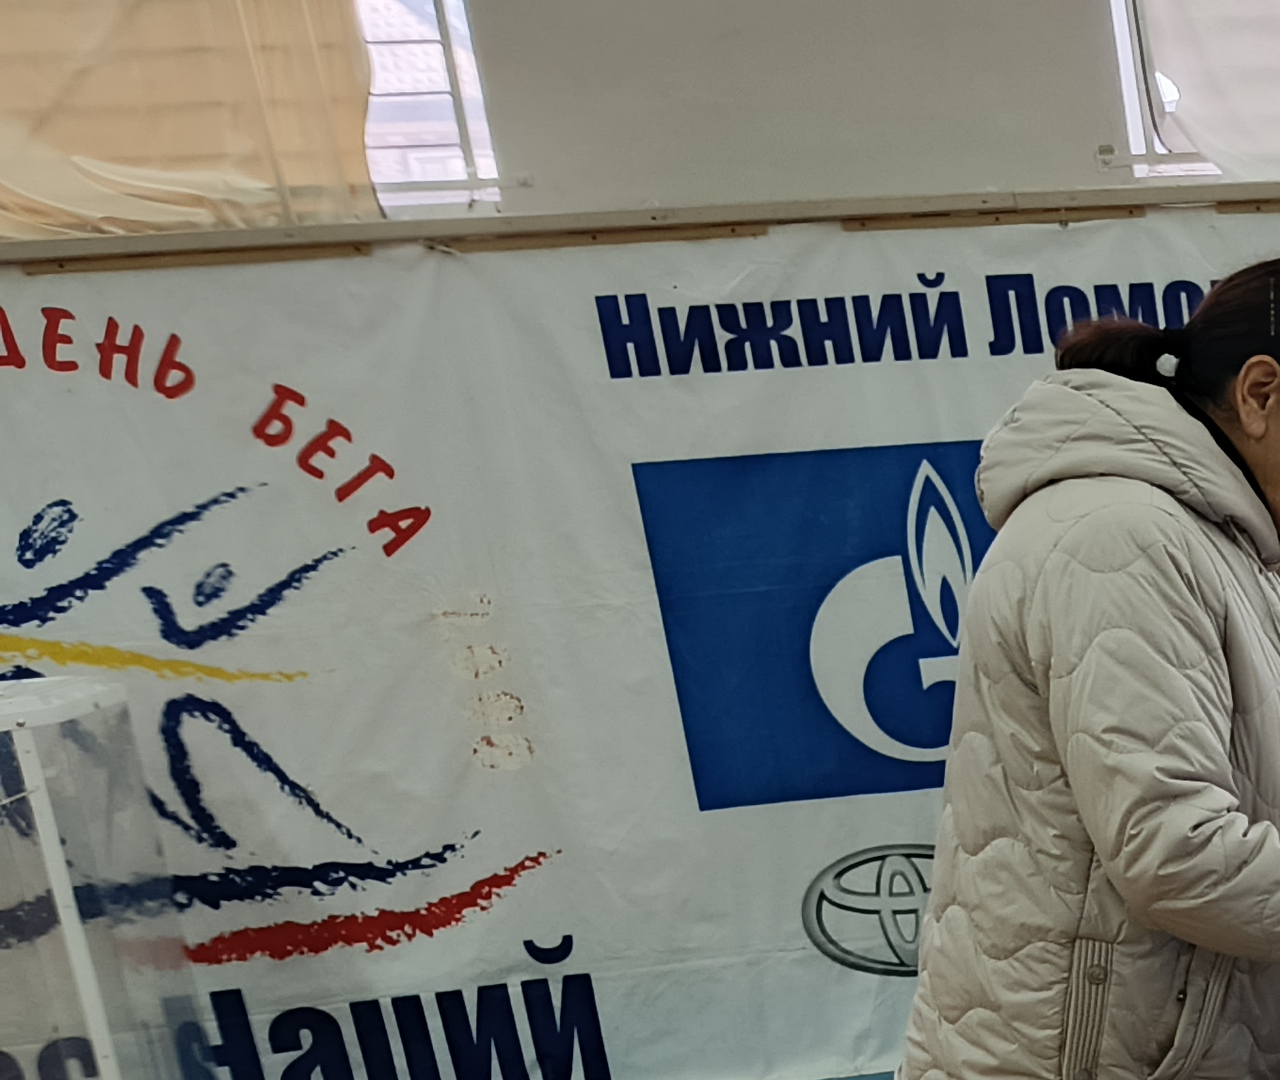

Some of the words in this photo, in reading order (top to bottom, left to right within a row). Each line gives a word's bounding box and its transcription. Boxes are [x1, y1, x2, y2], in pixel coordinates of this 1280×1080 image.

[594, 271, 969, 379] Нижний
[985, 273, 1222, 356] Ломо
[252, 382, 432, 558] БЕГА
